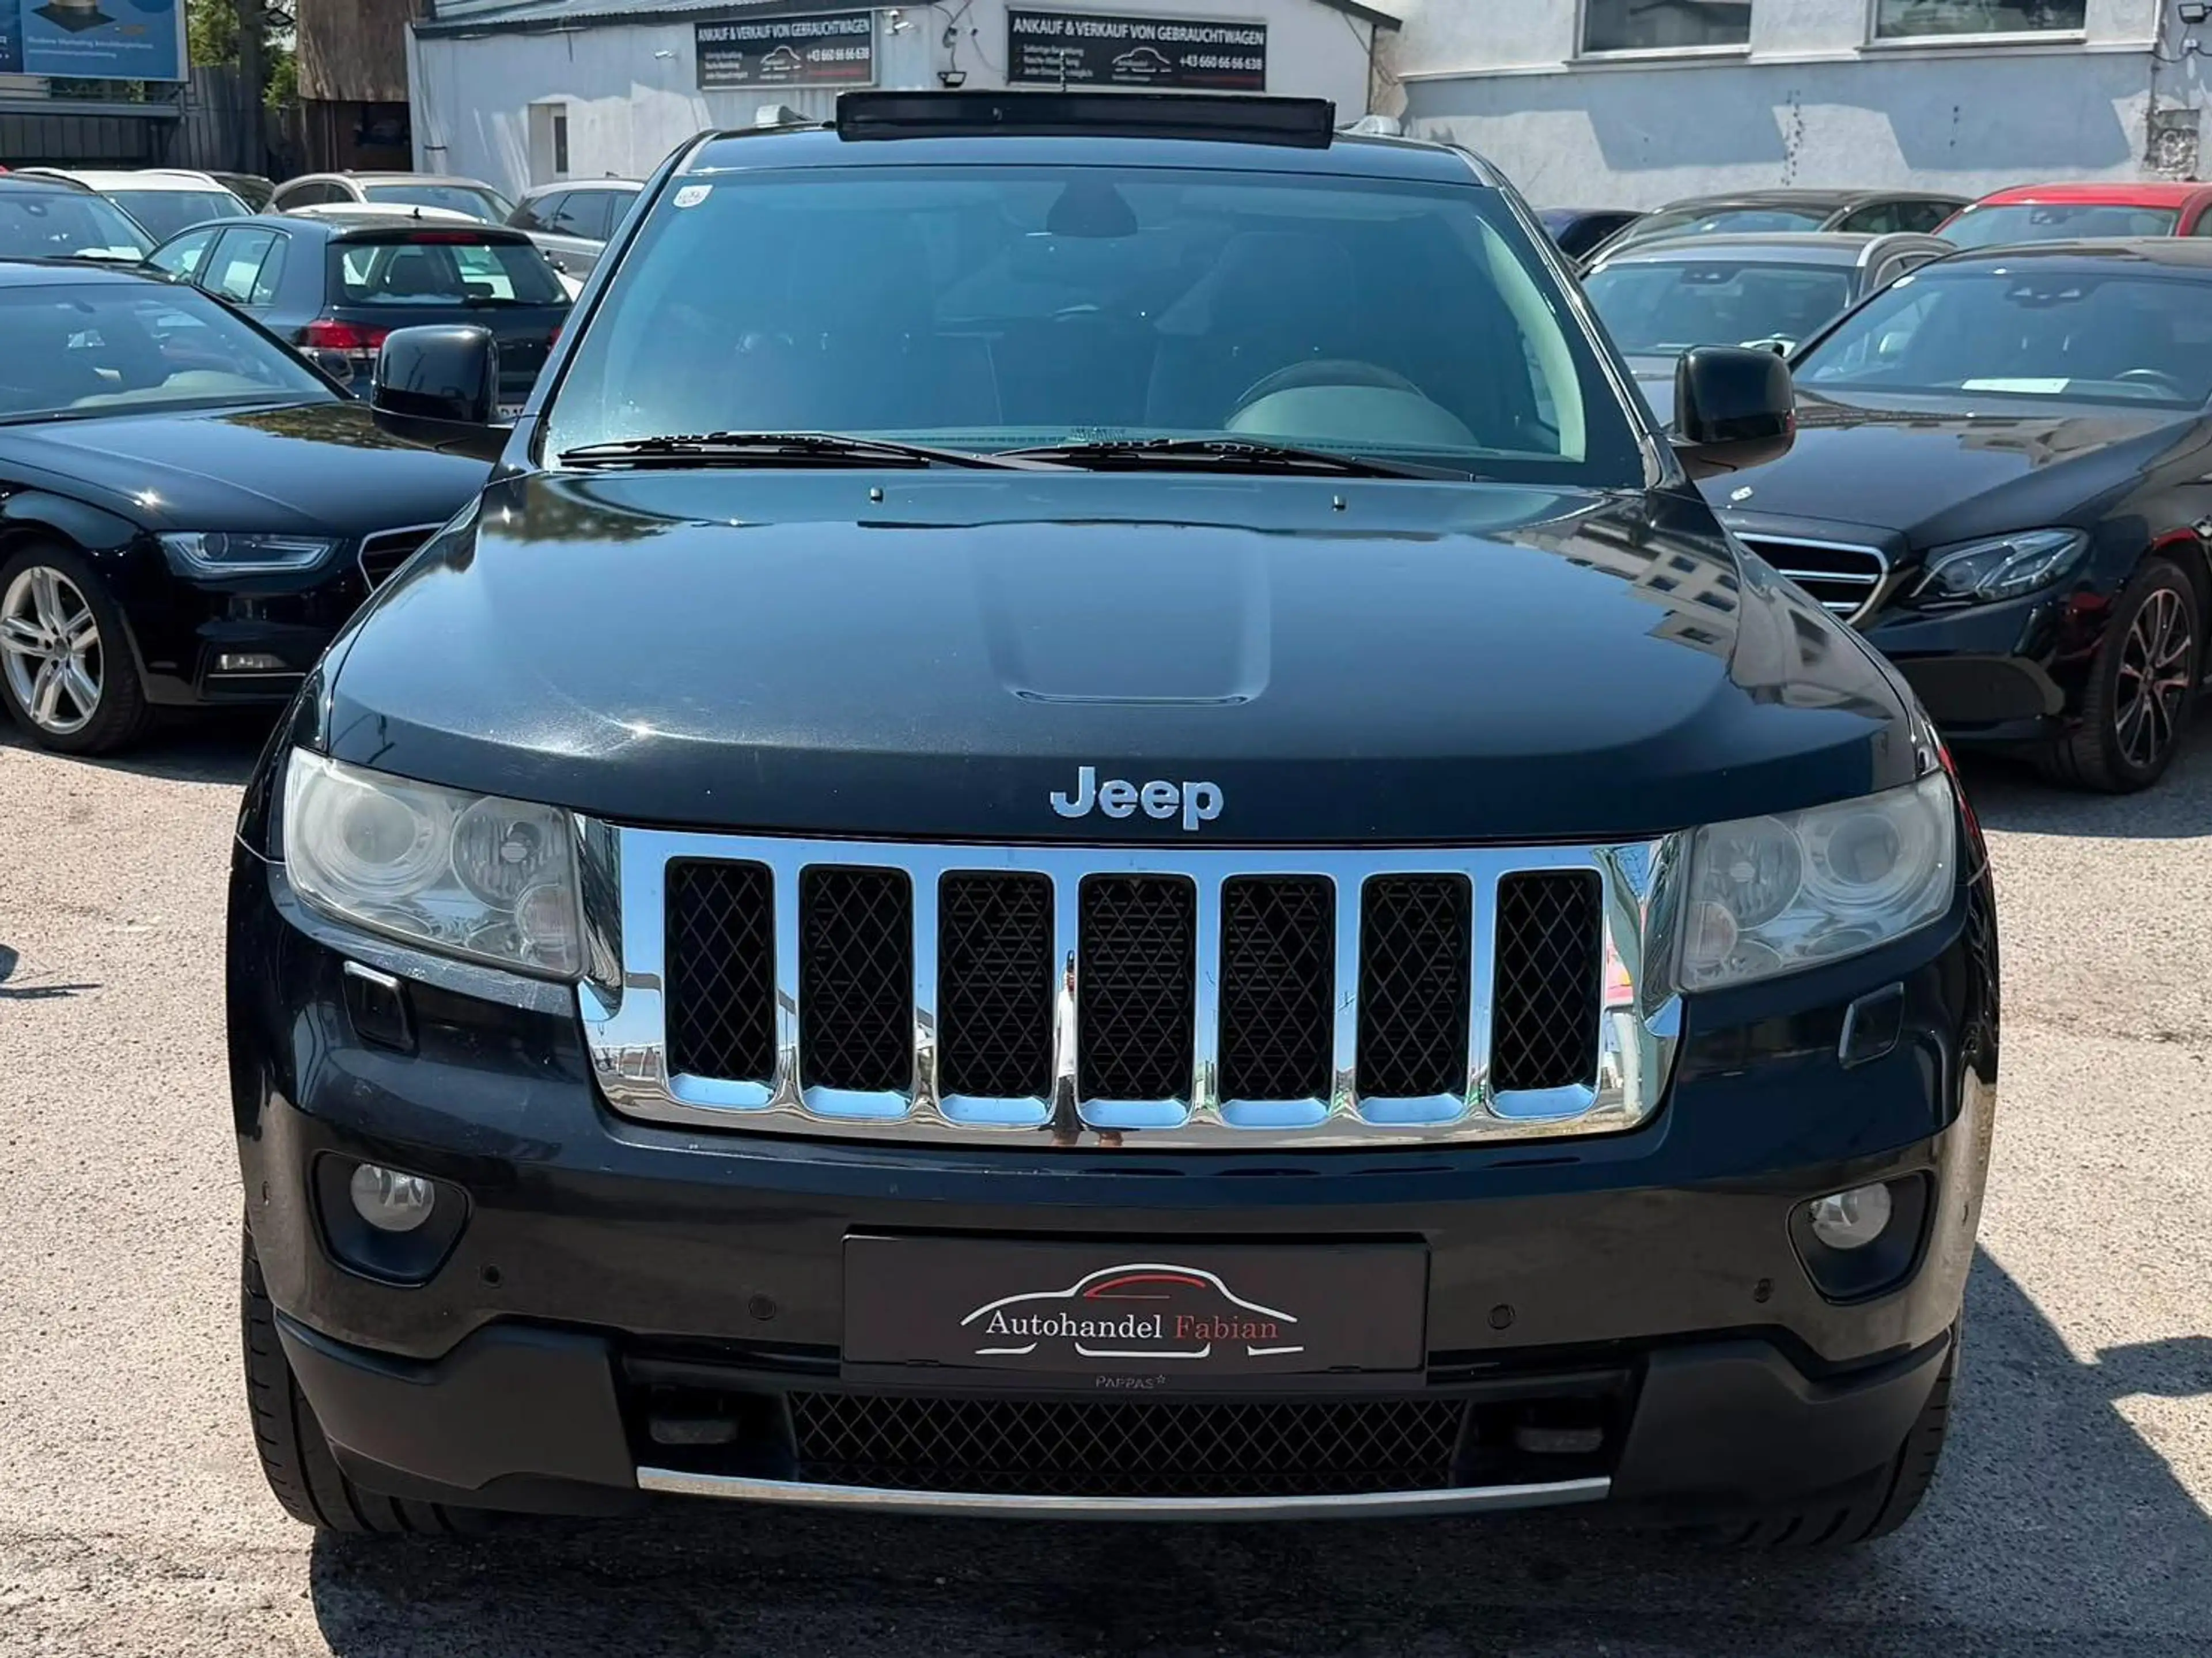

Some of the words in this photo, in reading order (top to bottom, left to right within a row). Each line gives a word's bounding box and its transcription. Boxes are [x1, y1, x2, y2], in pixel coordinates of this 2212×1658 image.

[1013, 17, 1063, 35] ANKAUF
[1065, 21, 1074, 35] &
[1075, 21, 1128, 38] VERKAUF
[1130, 24, 1156, 40] VON
[1157, 25, 1264, 45] GEBRAUCHTWAGEN
[1180, 55, 1198, 67] +43
[1050, 766, 1224, 831] Jeep
[986, 1310, 1162, 1339] Autohandel
[1173, 1315, 1279, 1340] Fabian
